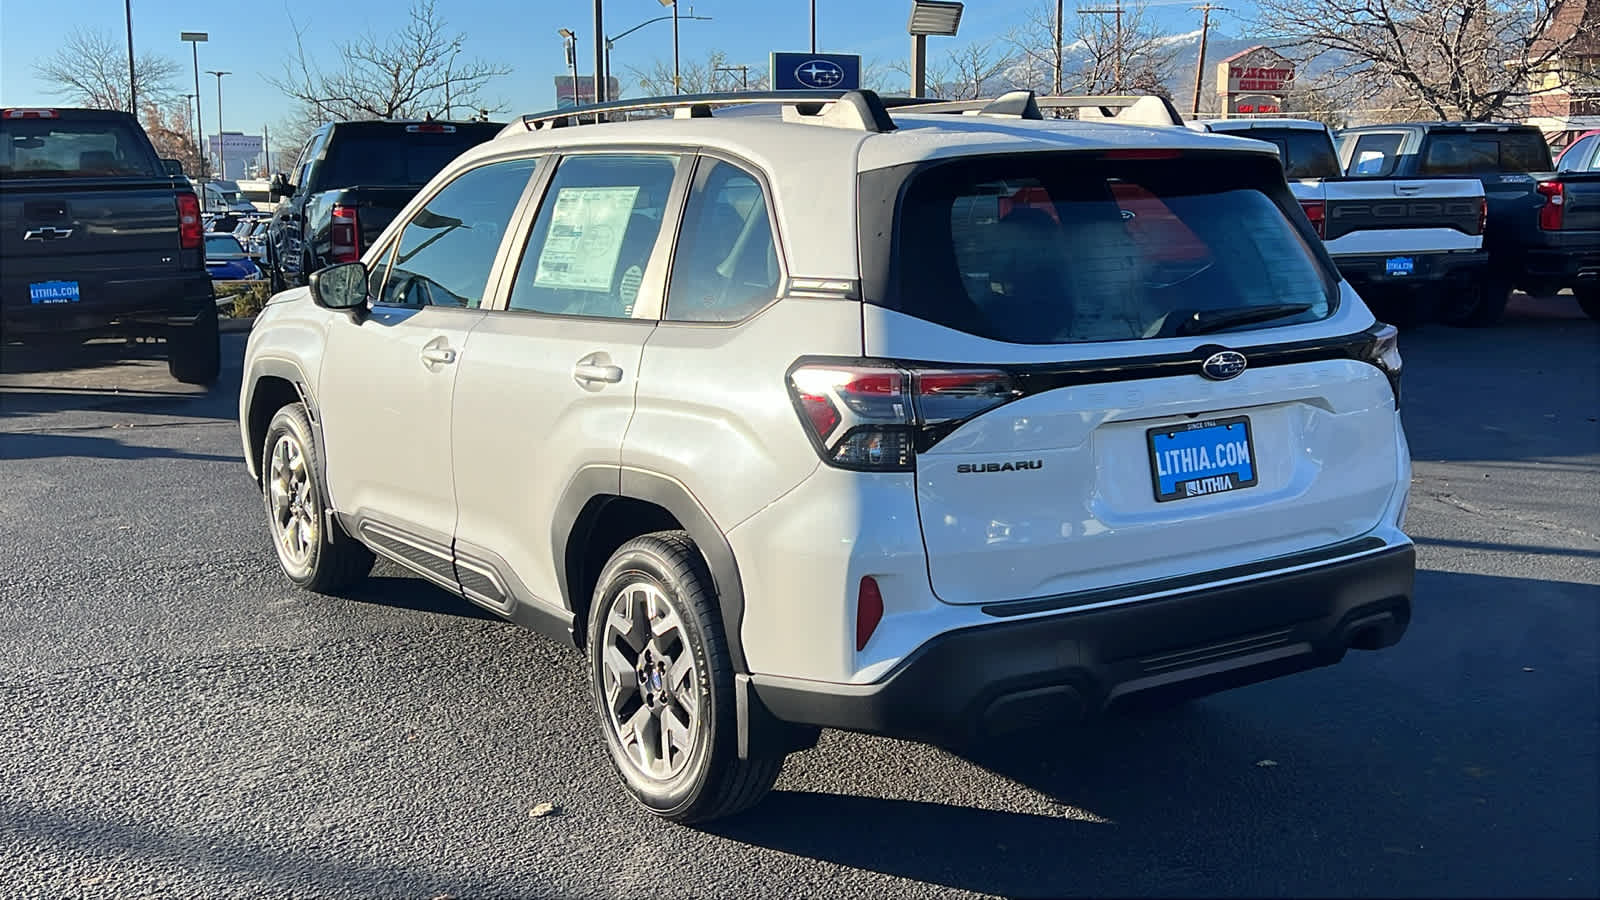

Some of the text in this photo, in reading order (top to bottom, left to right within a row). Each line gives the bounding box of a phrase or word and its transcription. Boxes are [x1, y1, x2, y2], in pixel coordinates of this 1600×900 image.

[30, 286, 80, 298] LITHIA.COM
[957, 459, 1043, 473] SUBARU
[1155, 440, 1250, 476] LITHIA.COM
[1196, 475, 1233, 495] LITHIA
